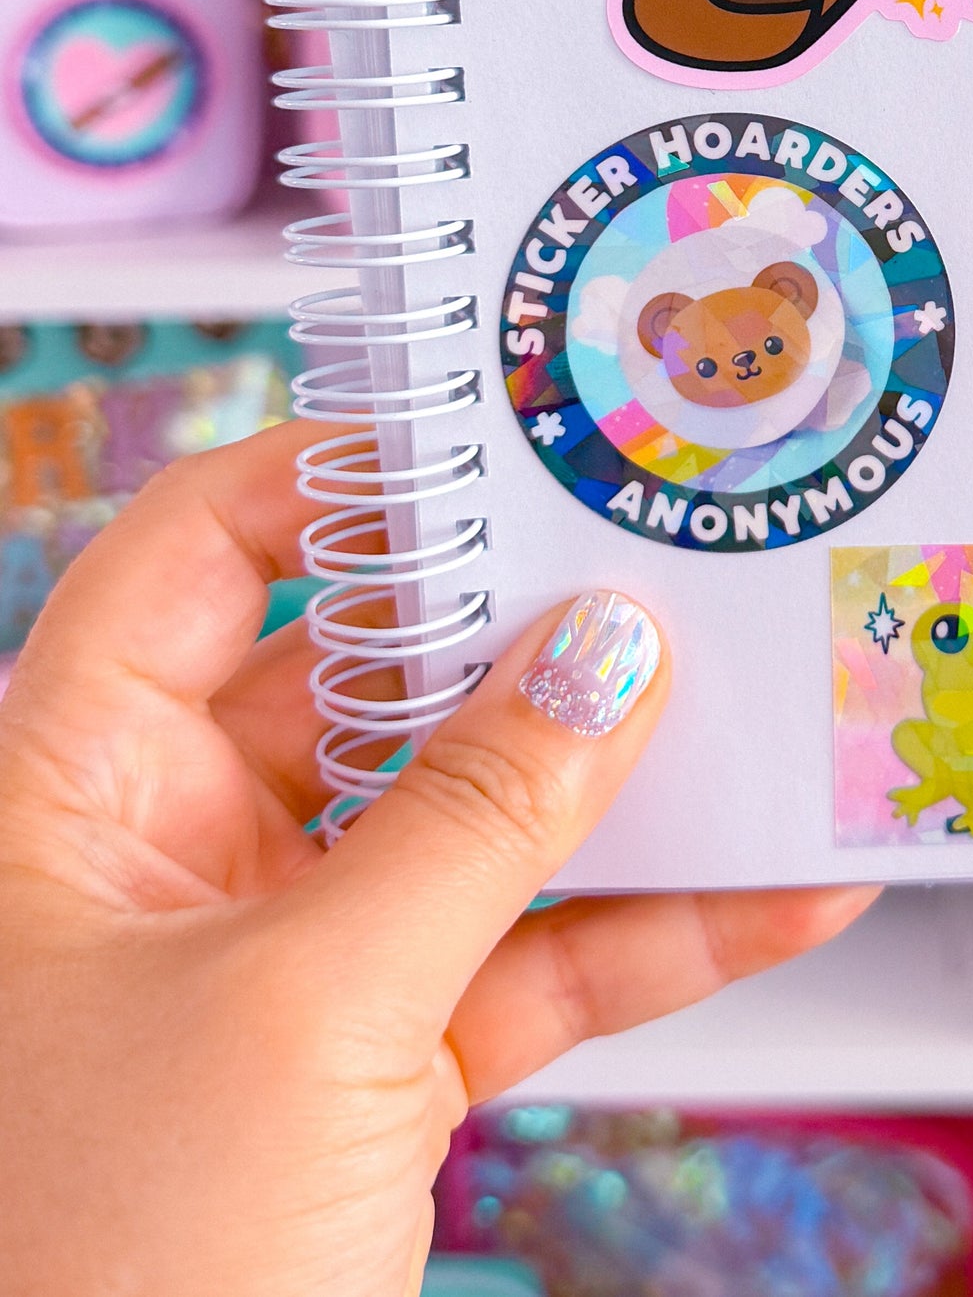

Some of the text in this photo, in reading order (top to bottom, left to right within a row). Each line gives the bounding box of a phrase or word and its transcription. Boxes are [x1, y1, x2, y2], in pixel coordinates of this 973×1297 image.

[506, 121, 926, 356] STICKER HOARDERS
[605, 393, 934, 543] ANONYMOUS
